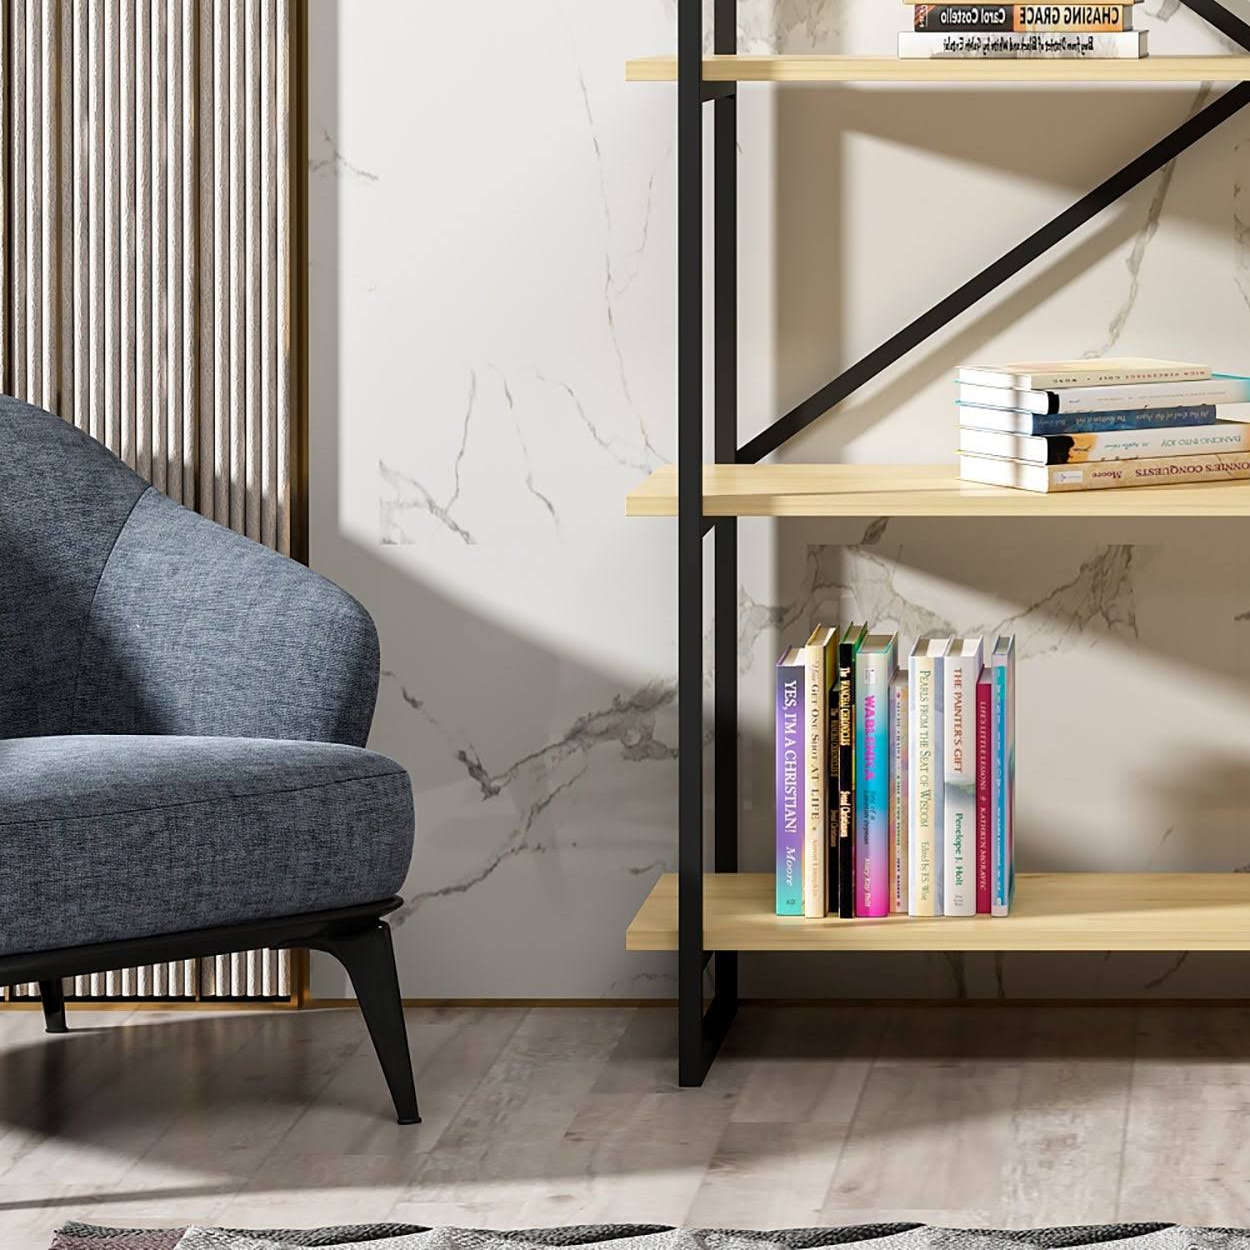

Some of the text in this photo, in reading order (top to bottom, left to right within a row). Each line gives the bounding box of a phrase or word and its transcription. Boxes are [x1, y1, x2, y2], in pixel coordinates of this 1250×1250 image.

[1160, 439, 1178, 447] JOY
[1092, 470, 1122, 479] Moore
[1136, 465, 1203, 478] CONQUESTS
[954, 668, 963, 774] THE PAINTER'S GIFT
[782, 680, 798, 833] YES, I'M A CHRISTIAN!
[920, 670, 931, 827] PEARLS FROM THE SEAT OF WISDOM
[811, 764, 820, 782] AT
[811, 789, 820, 819] LIFE
[953, 813, 963, 855] Penelope
[785, 845, 797, 886] Moore
[955, 866, 964, 886] Holt
